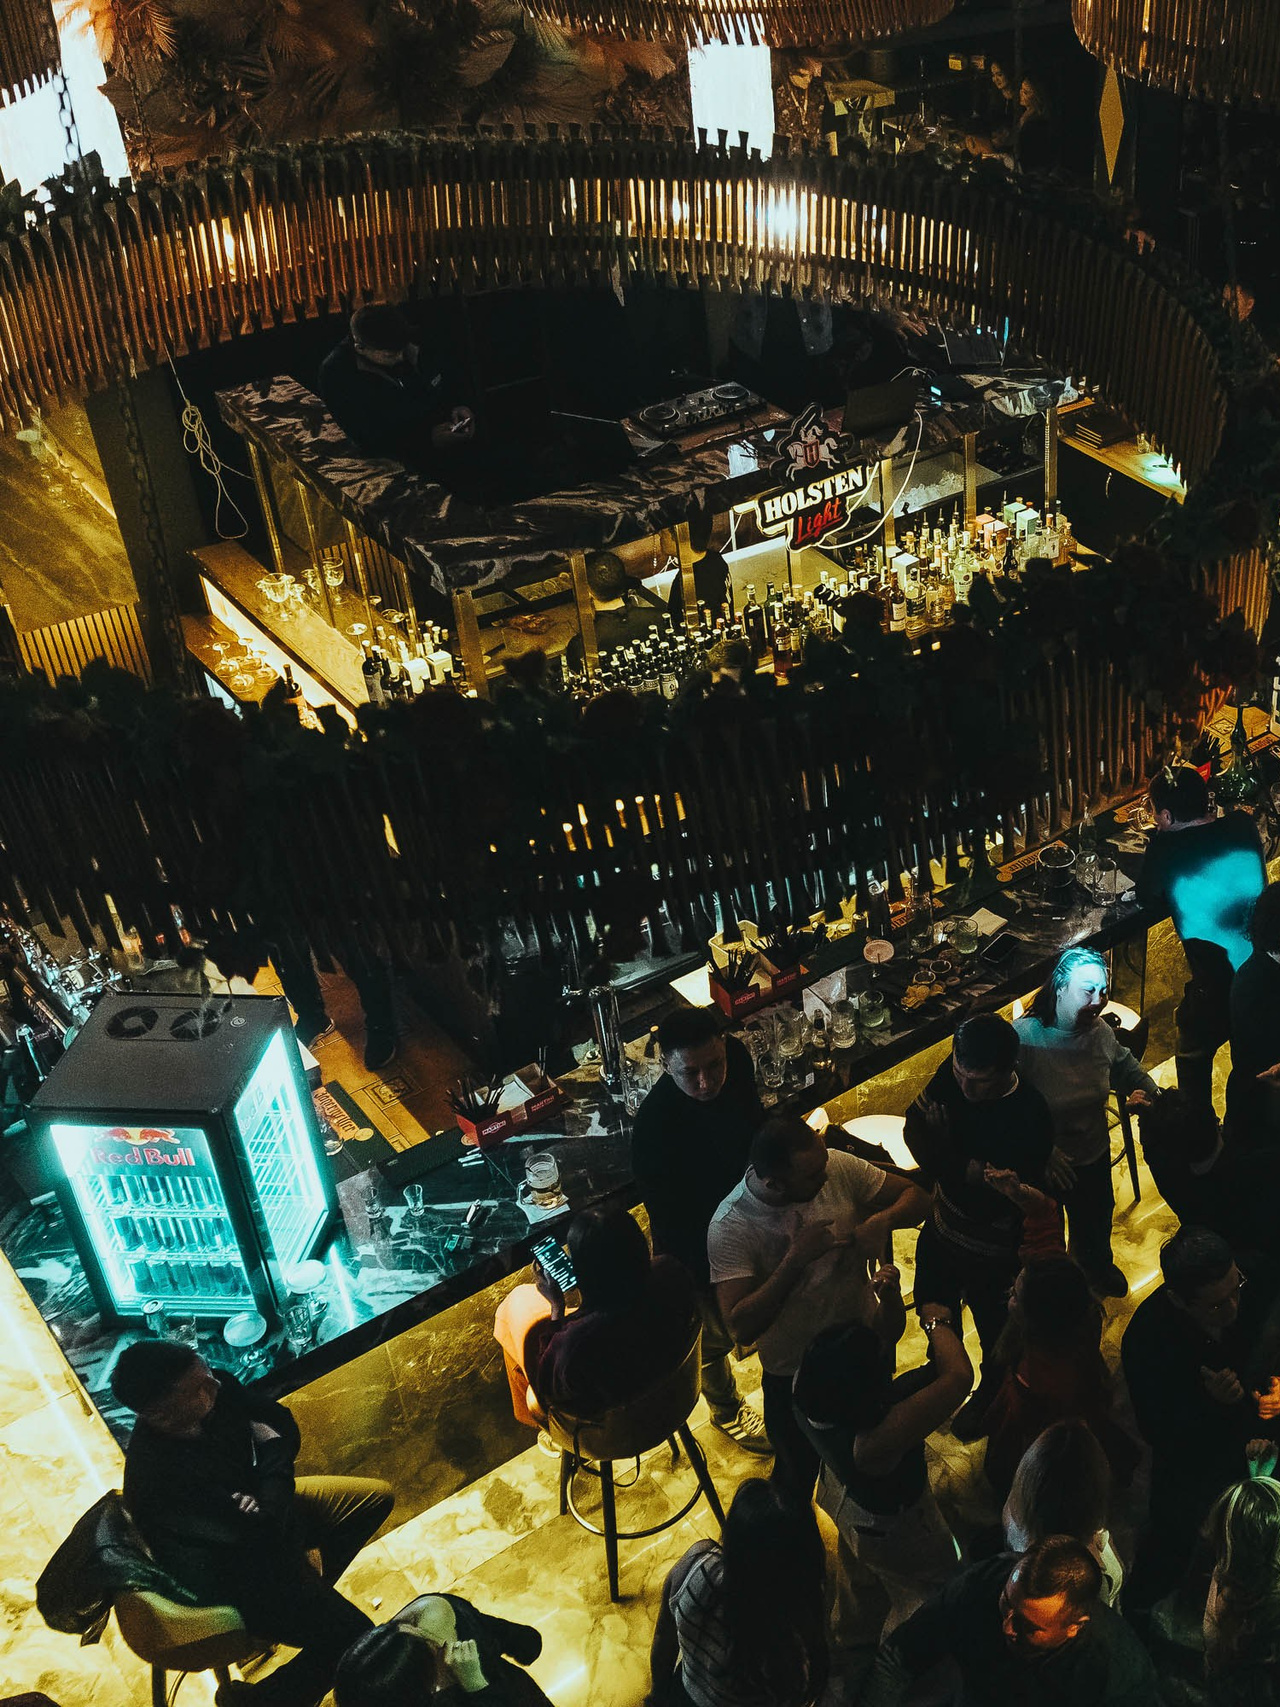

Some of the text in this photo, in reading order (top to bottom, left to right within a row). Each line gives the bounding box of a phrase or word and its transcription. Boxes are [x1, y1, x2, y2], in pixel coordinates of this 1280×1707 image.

[763, 465, 864, 523] HOLSTEN
[795, 498, 843, 545] Light
[91, 1147, 196, 1167] Red Bull
